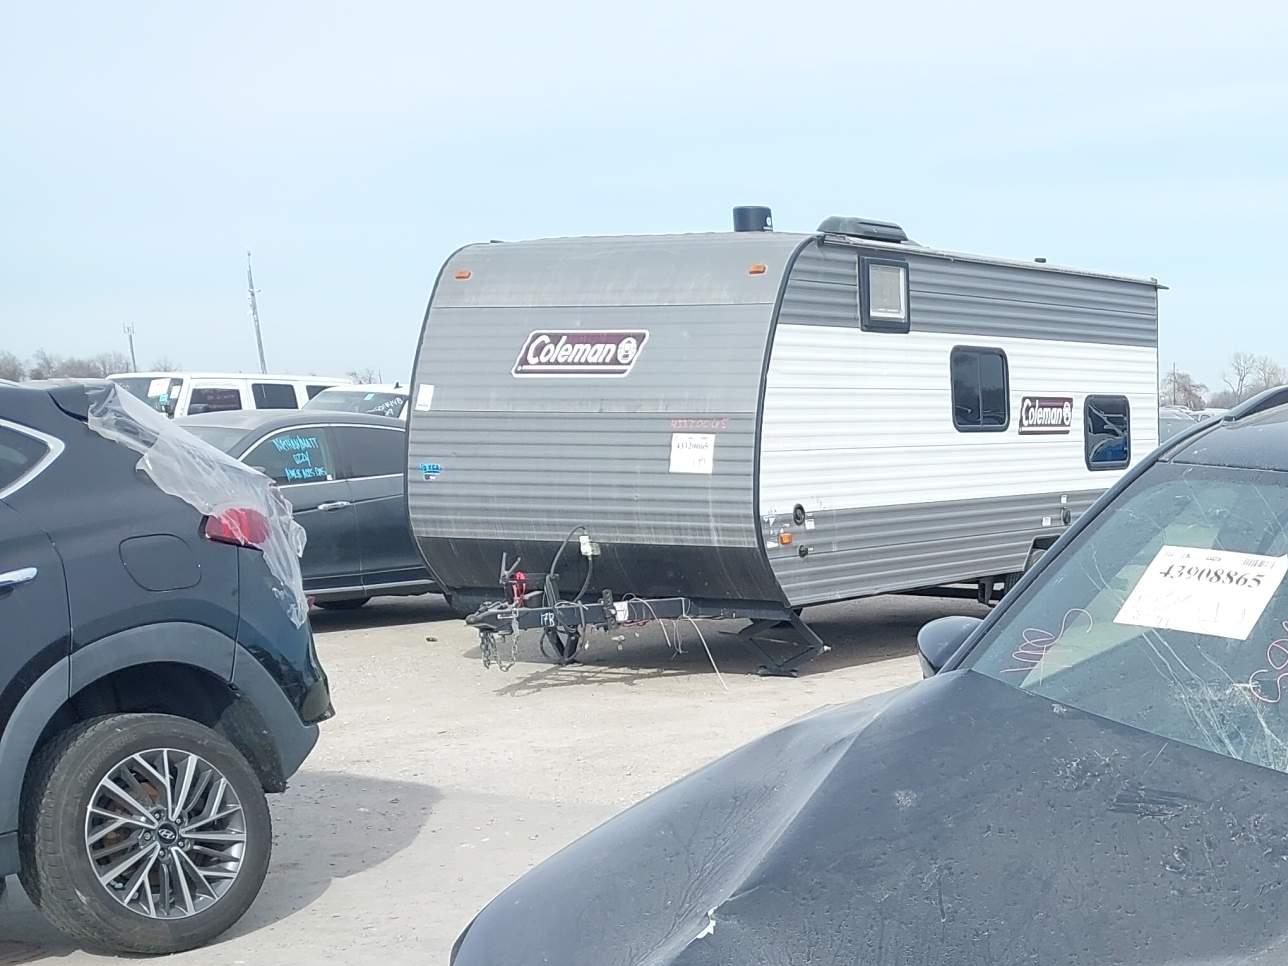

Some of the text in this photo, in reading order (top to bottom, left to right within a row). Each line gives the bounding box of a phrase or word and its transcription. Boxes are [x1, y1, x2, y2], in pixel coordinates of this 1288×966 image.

[527, 335, 616, 364] Coleman
[1022, 398, 1063, 427] Coleman
[1160, 564, 1265, 589] 43908865
